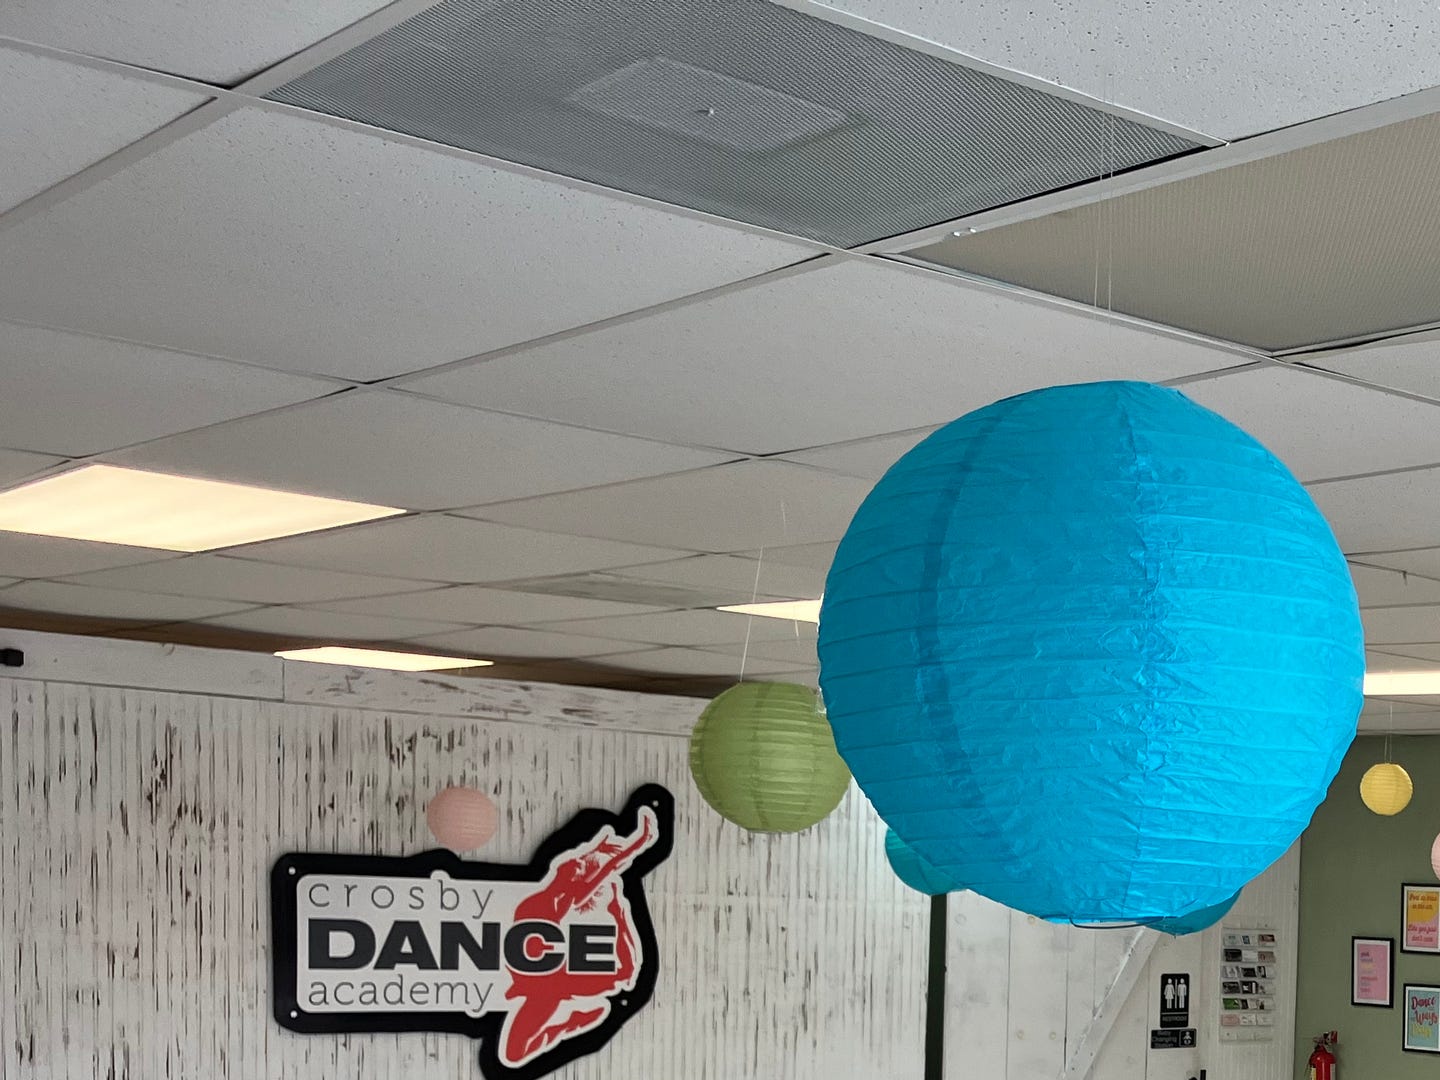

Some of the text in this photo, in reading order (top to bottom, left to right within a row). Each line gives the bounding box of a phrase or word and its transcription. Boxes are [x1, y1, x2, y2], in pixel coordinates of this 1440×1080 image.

[308, 880, 494, 919] crosby
[308, 918, 616, 973] DANCE
[308, 974, 494, 1012] academy
